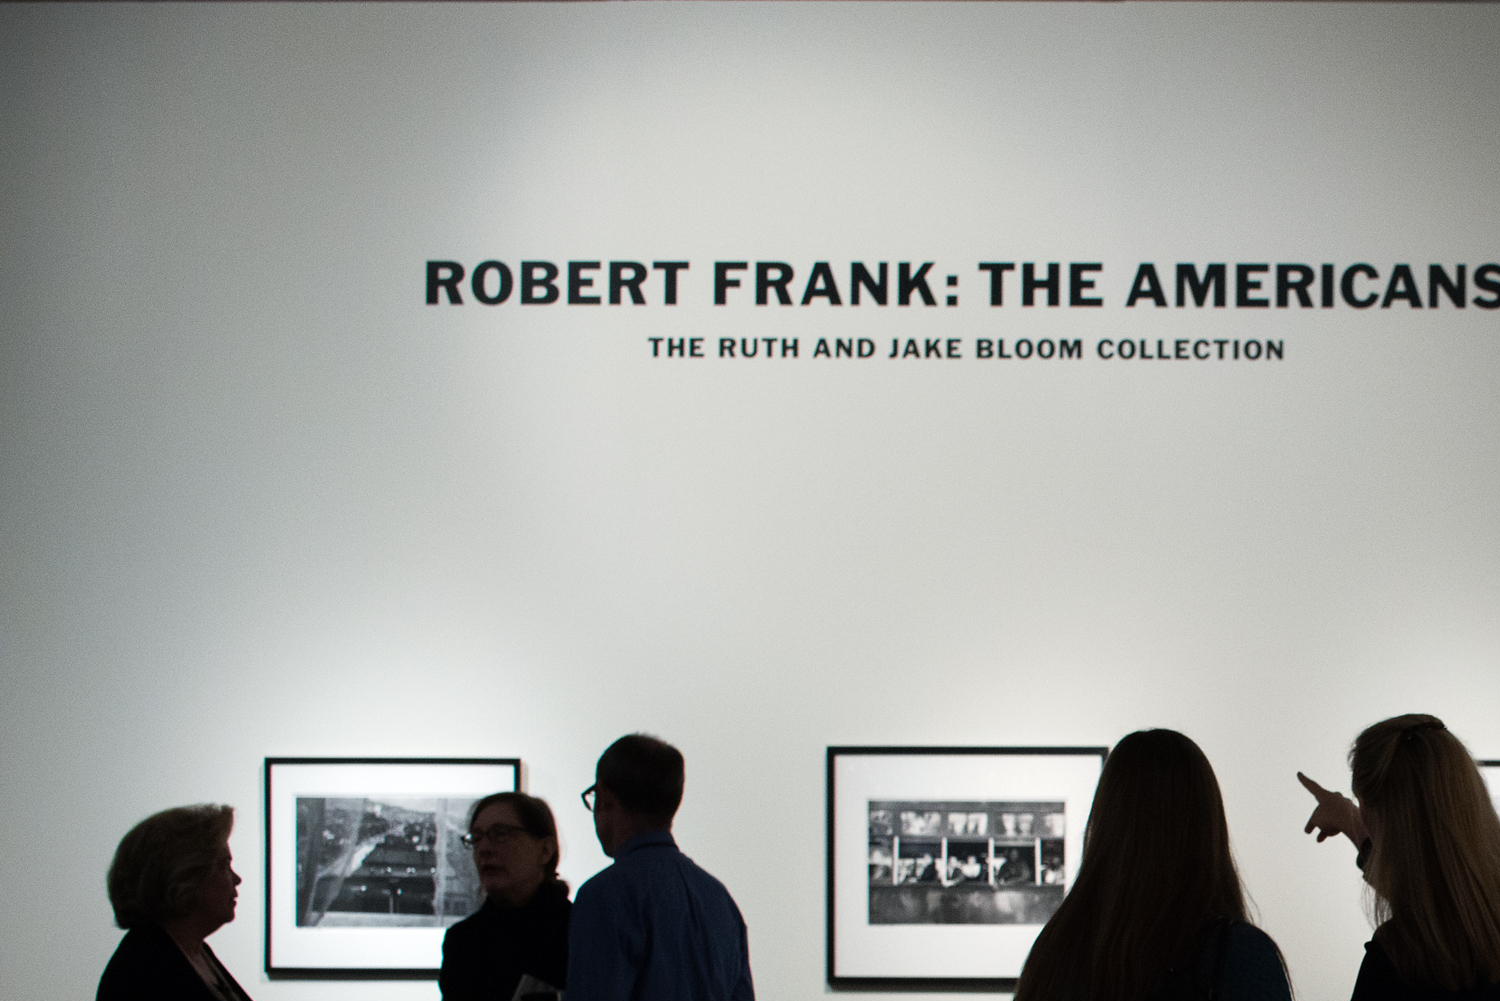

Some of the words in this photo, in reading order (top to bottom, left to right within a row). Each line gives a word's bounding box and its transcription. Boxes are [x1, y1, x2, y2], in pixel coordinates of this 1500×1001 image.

[425, 260, 690, 305] ROBERT
[714, 261, 958, 306] FRANK:
[978, 262, 1103, 305] THE
[648, 337, 704, 357] THE
[718, 338, 799, 357] RUTH
[813, 338, 875, 357] AND
[888, 338, 961, 358] JAKE
[975, 339, 1082, 358] BLOOM
[1097, 339, 1284, 359] COLLECTION
